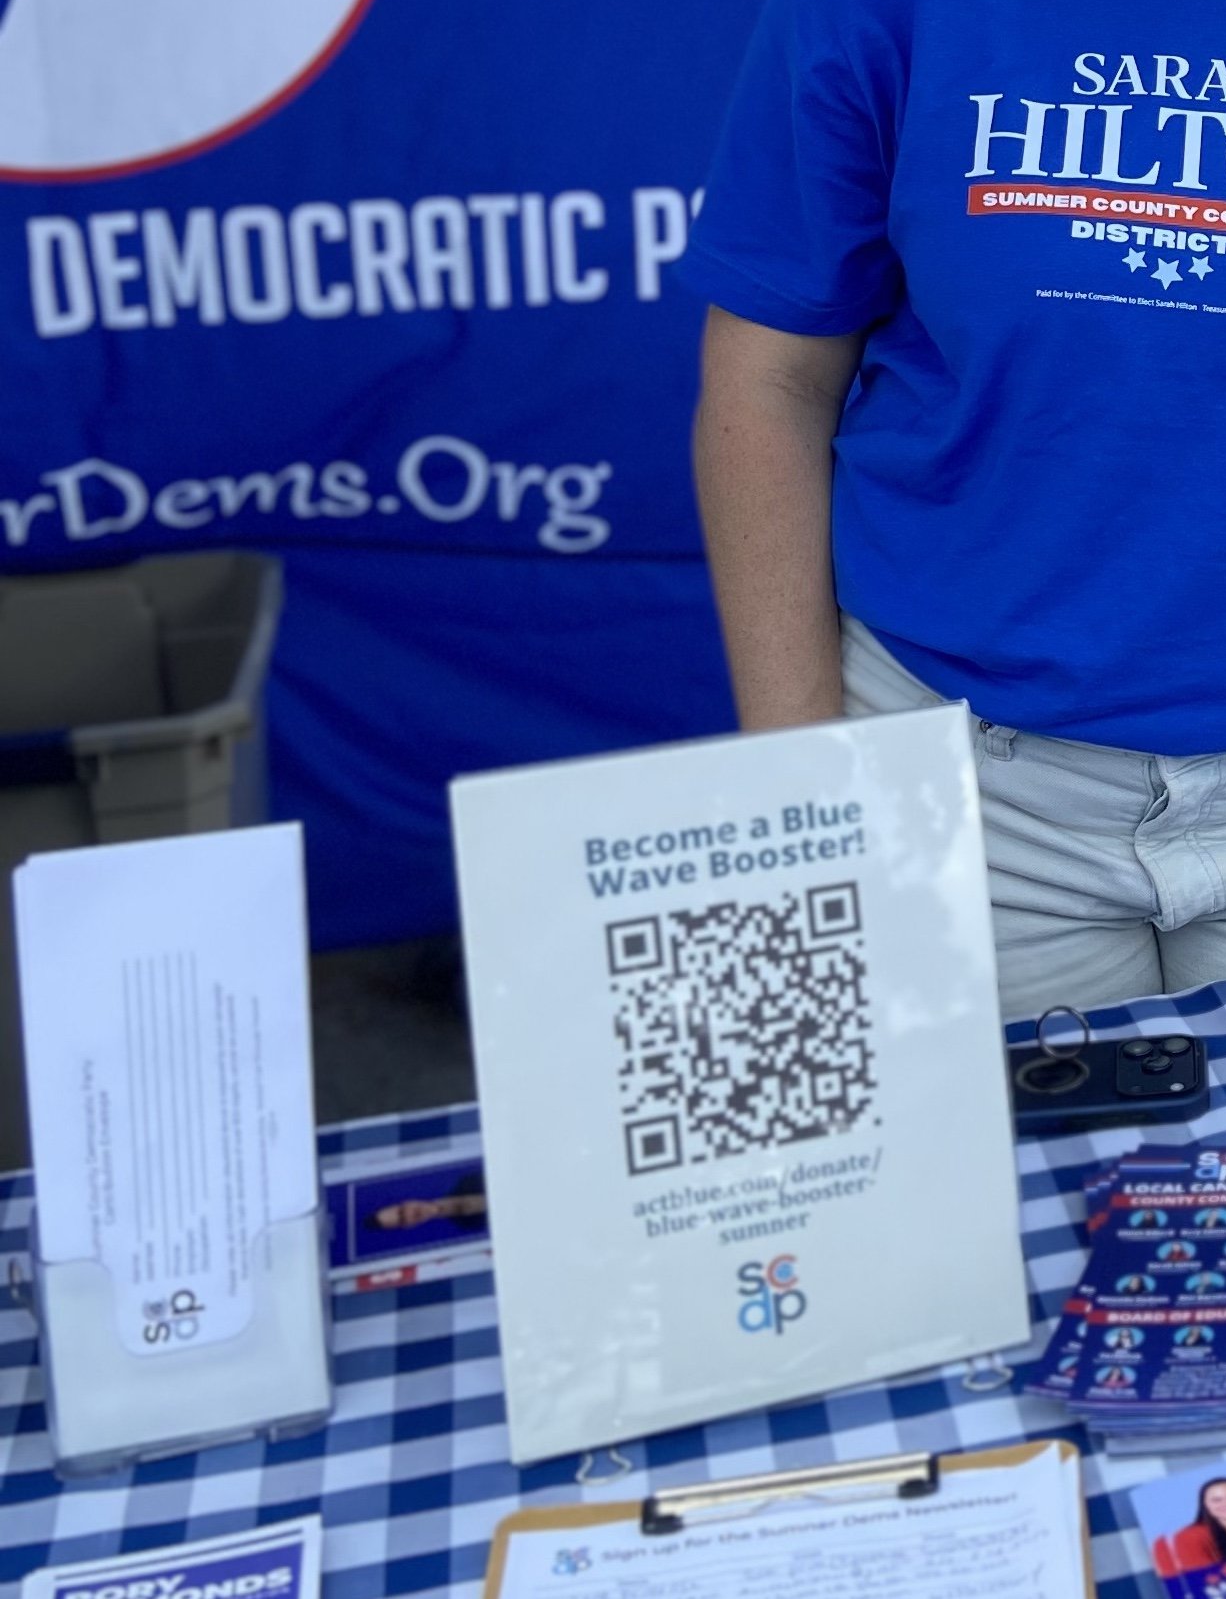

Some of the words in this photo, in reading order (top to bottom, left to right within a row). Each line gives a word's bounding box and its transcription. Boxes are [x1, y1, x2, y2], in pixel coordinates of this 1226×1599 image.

[982, 191, 1087, 210] SUMNER
[1092, 197, 1199, 220] COUNTY
[26, 190, 608, 340] DEMOCRATIC
[632, 186, 706, 302] P
[1036, 289, 1051, 298] Paid
[1052, 290, 1063, 298] for
[1064, 291, 1074, 301] by
[1075, 292, 1087, 301] the
[1128, 296, 1137, 304] to
[585, 820, 738, 867] Become
[748, 815, 772, 840] a
[781, 800, 864, 835] Blue
[587, 860, 698, 899] Wave
[708, 826, 866, 880] Booster!
[632, 1146, 884, 1220] actblue.com/donate/
[1122, 1181, 1186, 1195] LOCAL
[718, 1210, 812, 1246] sumner
[1106, 1311, 1167, 1324] BOARD
[1168, 1310, 1192, 1322] OF
